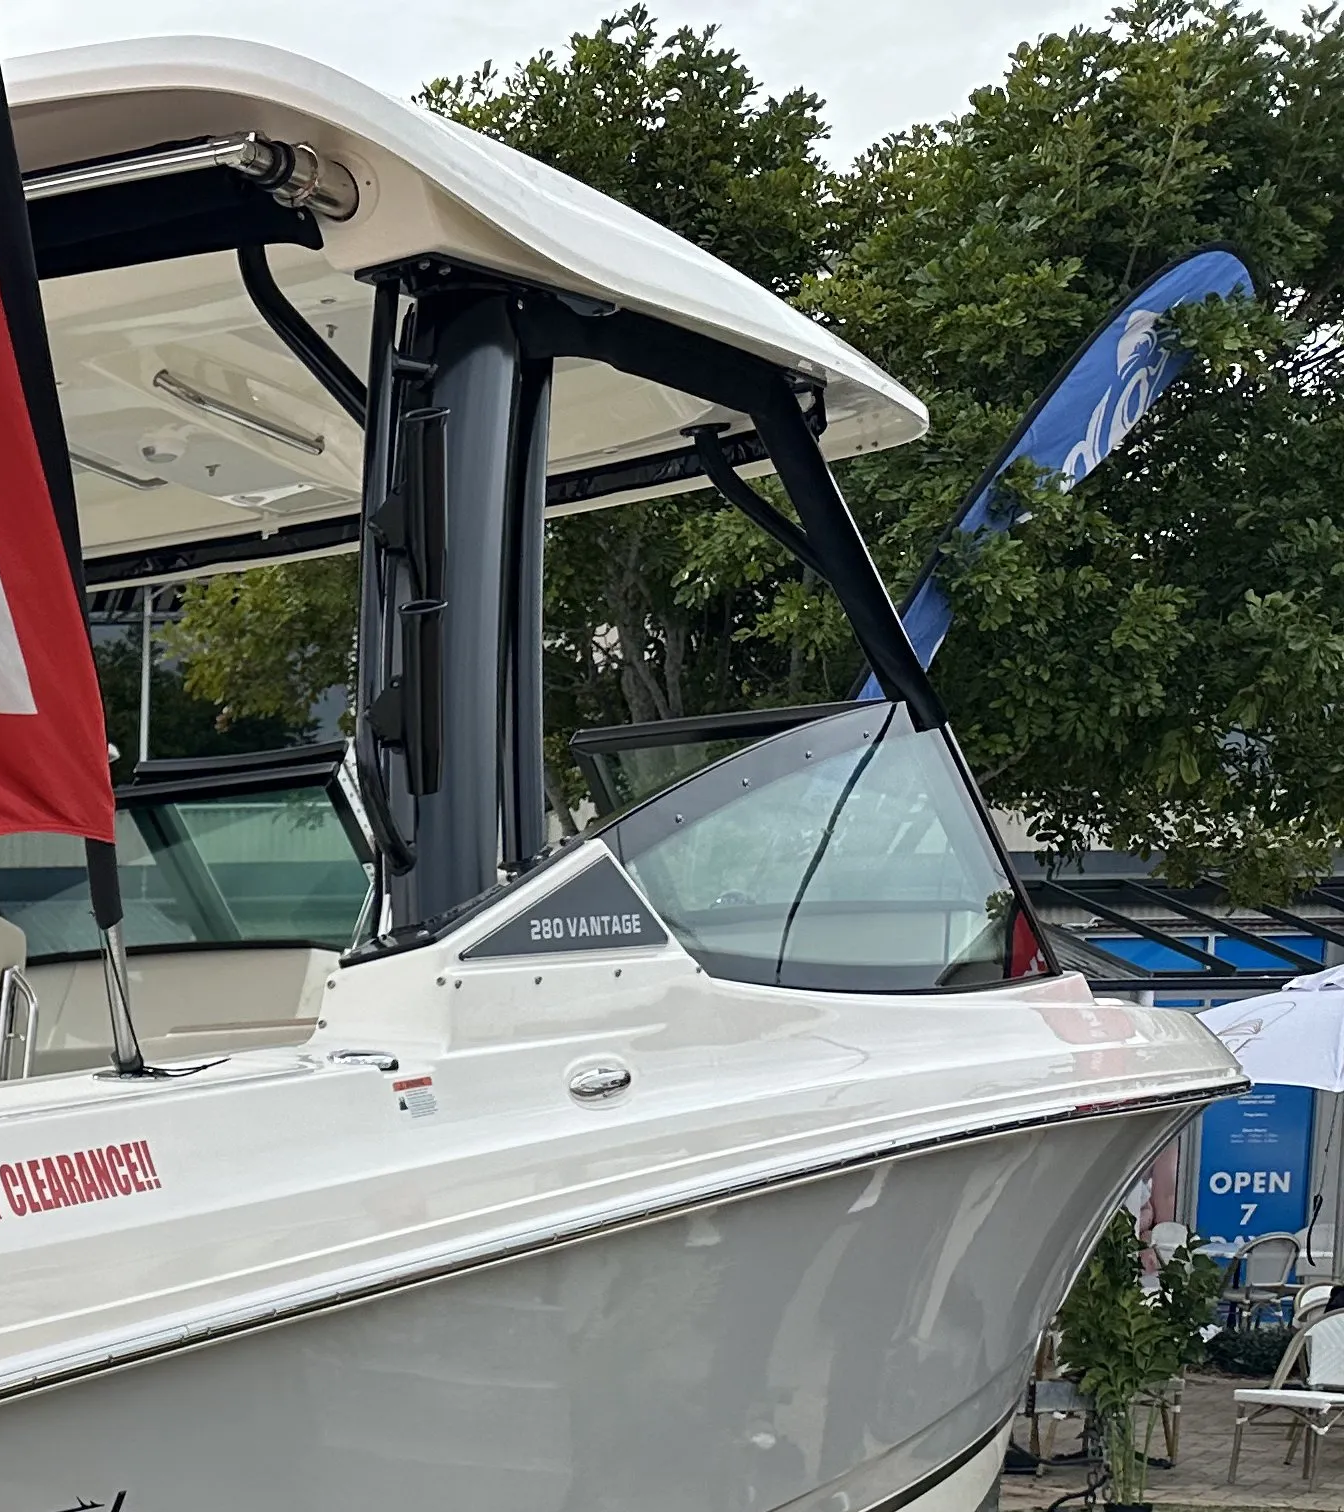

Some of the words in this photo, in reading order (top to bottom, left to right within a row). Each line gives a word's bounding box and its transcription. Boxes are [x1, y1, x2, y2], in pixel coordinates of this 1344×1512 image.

[530, 918, 564, 940] 280
[566, 914, 642, 937] VANTAGE
[0, 1140, 162, 1217] CLEARANCE!!
[1209, 1171, 1291, 1195] OPEN
[1239, 1203, 1258, 1226] 7
